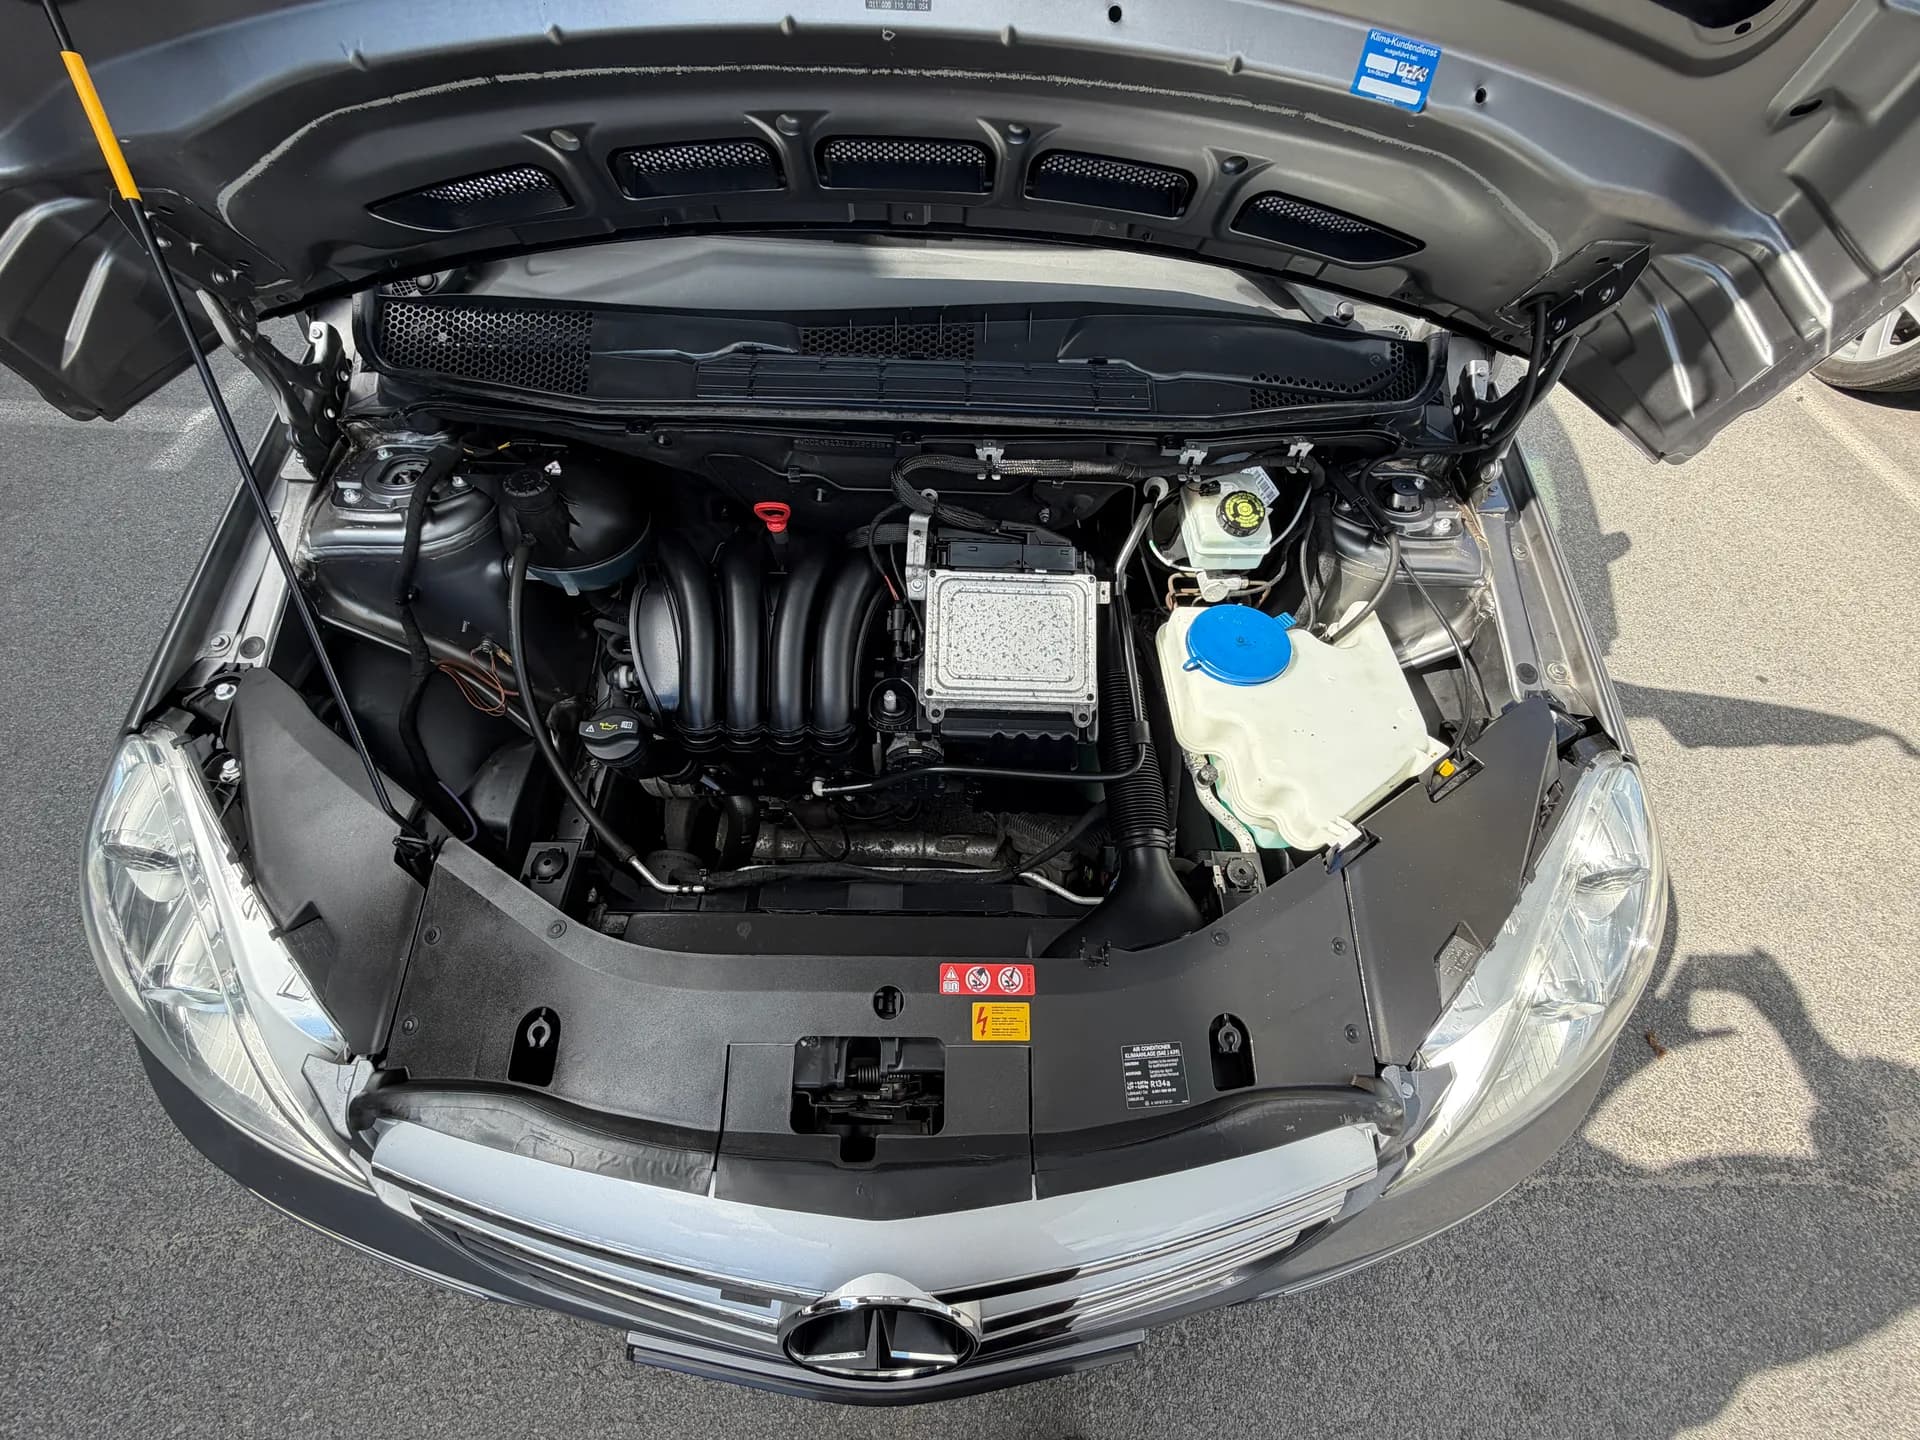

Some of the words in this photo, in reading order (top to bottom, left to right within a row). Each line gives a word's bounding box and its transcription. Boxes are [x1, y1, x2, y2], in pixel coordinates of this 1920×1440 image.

[1370, 31, 1438, 58] Klima-Kundendienst
[1124, 1050, 1156, 1058] KLIMAANLAGE
[1150, 1079, 1171, 1088] R134a
